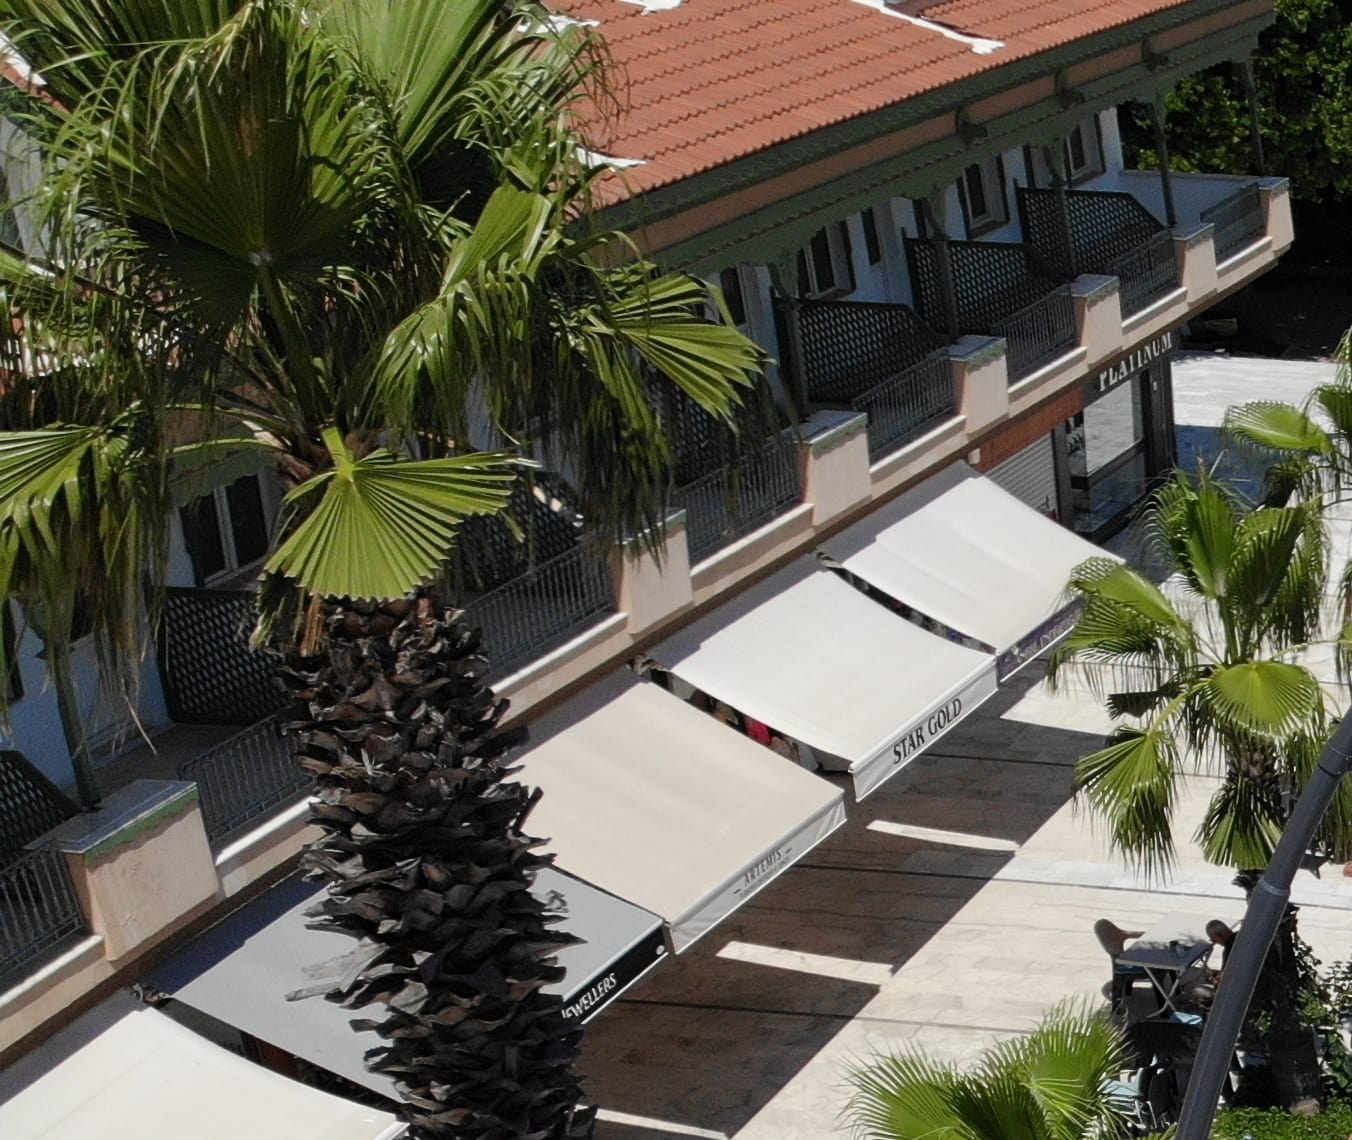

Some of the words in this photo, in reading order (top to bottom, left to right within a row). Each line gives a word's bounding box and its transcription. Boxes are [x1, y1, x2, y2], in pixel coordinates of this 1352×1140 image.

[1099, 331, 1172, 392] PLATINUM
[892, 726, 925, 765] STAR
[927, 698, 962, 736] GOLD
[743, 847, 782, 888] ARTEMIS
